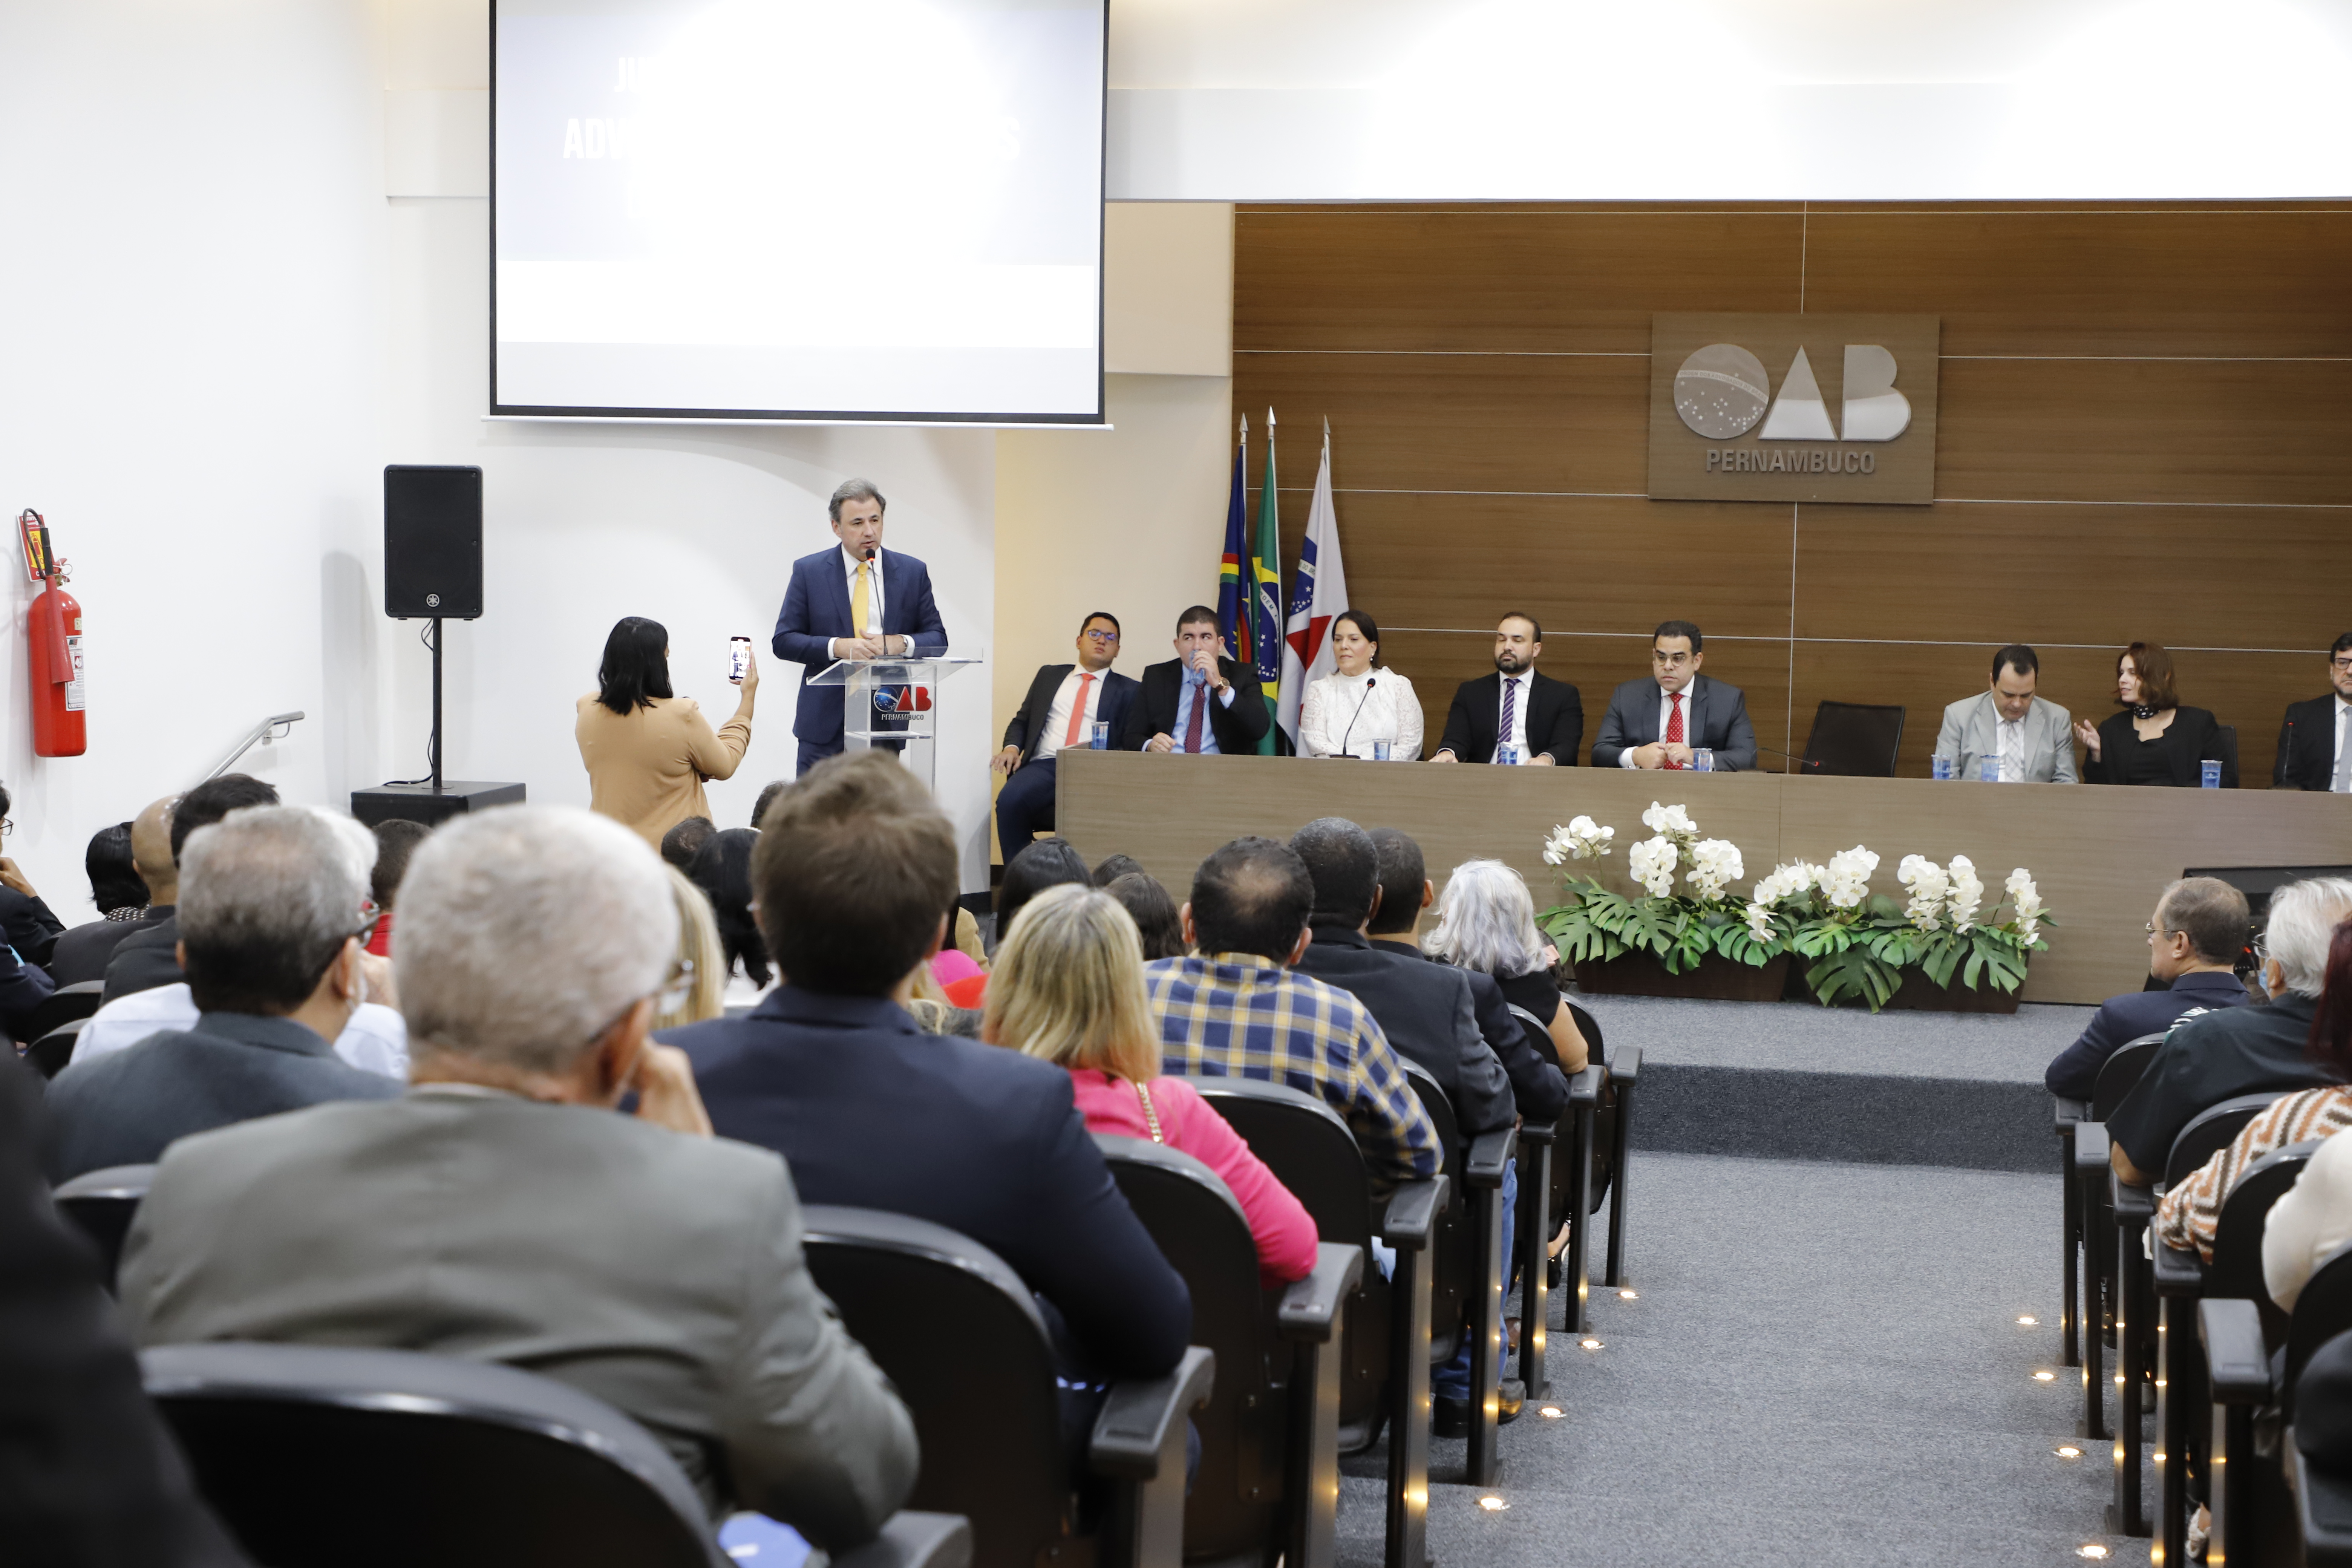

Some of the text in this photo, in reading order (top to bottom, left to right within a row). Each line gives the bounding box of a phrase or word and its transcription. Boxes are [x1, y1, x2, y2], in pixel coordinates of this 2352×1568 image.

[1674, 343, 1911, 441] OAB
[1706, 449, 1875, 473] PERNAMBUCO
[873, 686, 932, 712] OAB
